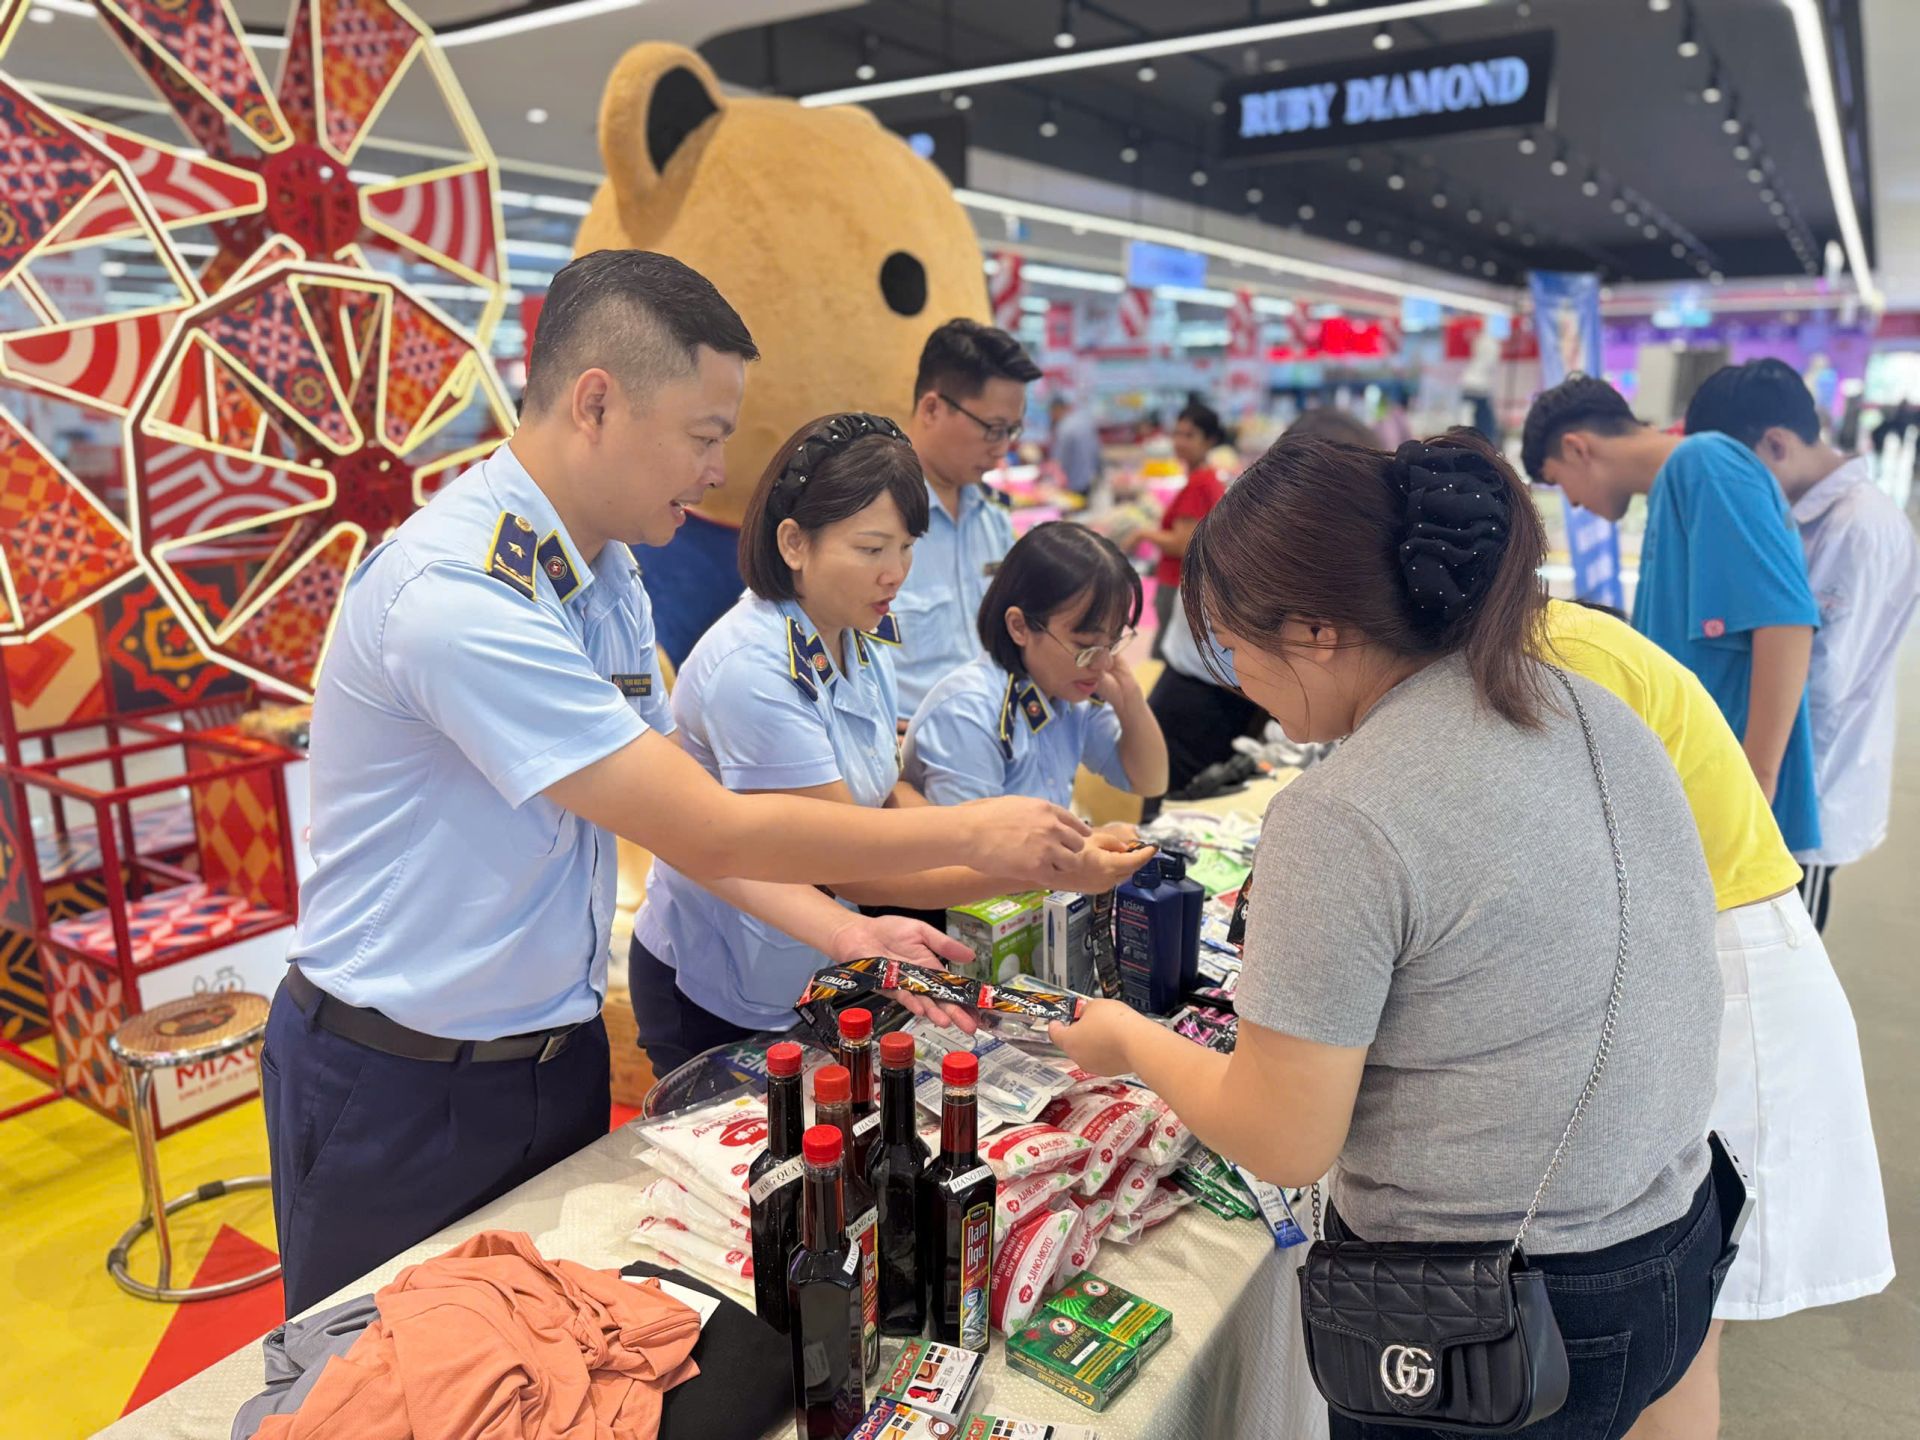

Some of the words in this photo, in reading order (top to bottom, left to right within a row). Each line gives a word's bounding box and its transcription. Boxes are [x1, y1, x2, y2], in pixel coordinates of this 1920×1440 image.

[1239, 83, 1338, 138] RUBY
[1342, 56, 1529, 125] DIAMOND
[1053, 1339, 1071, 1358] EAGLE
